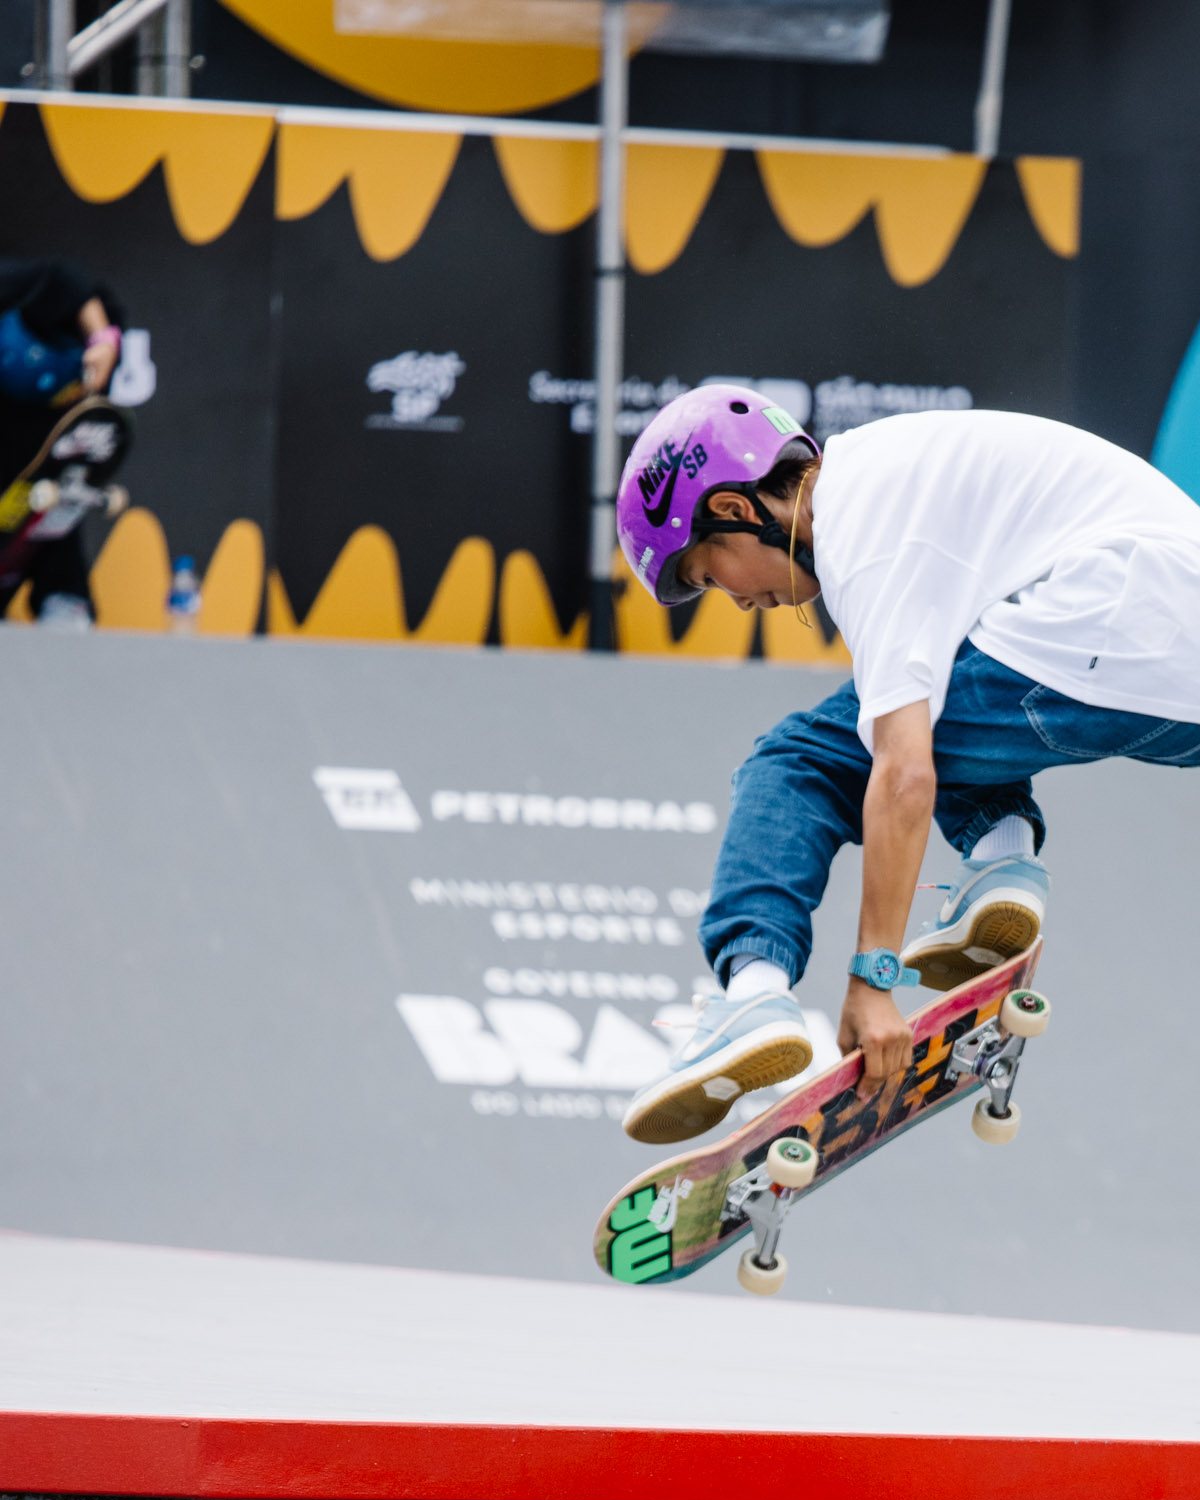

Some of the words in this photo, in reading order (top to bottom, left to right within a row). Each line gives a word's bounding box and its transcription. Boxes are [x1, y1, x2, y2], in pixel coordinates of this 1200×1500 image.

[637, 434, 684, 505] NIKE
[682, 443, 708, 480] SB
[431, 789, 718, 834] PETROBRAS
[483, 966, 680, 1002] GOVERNO
